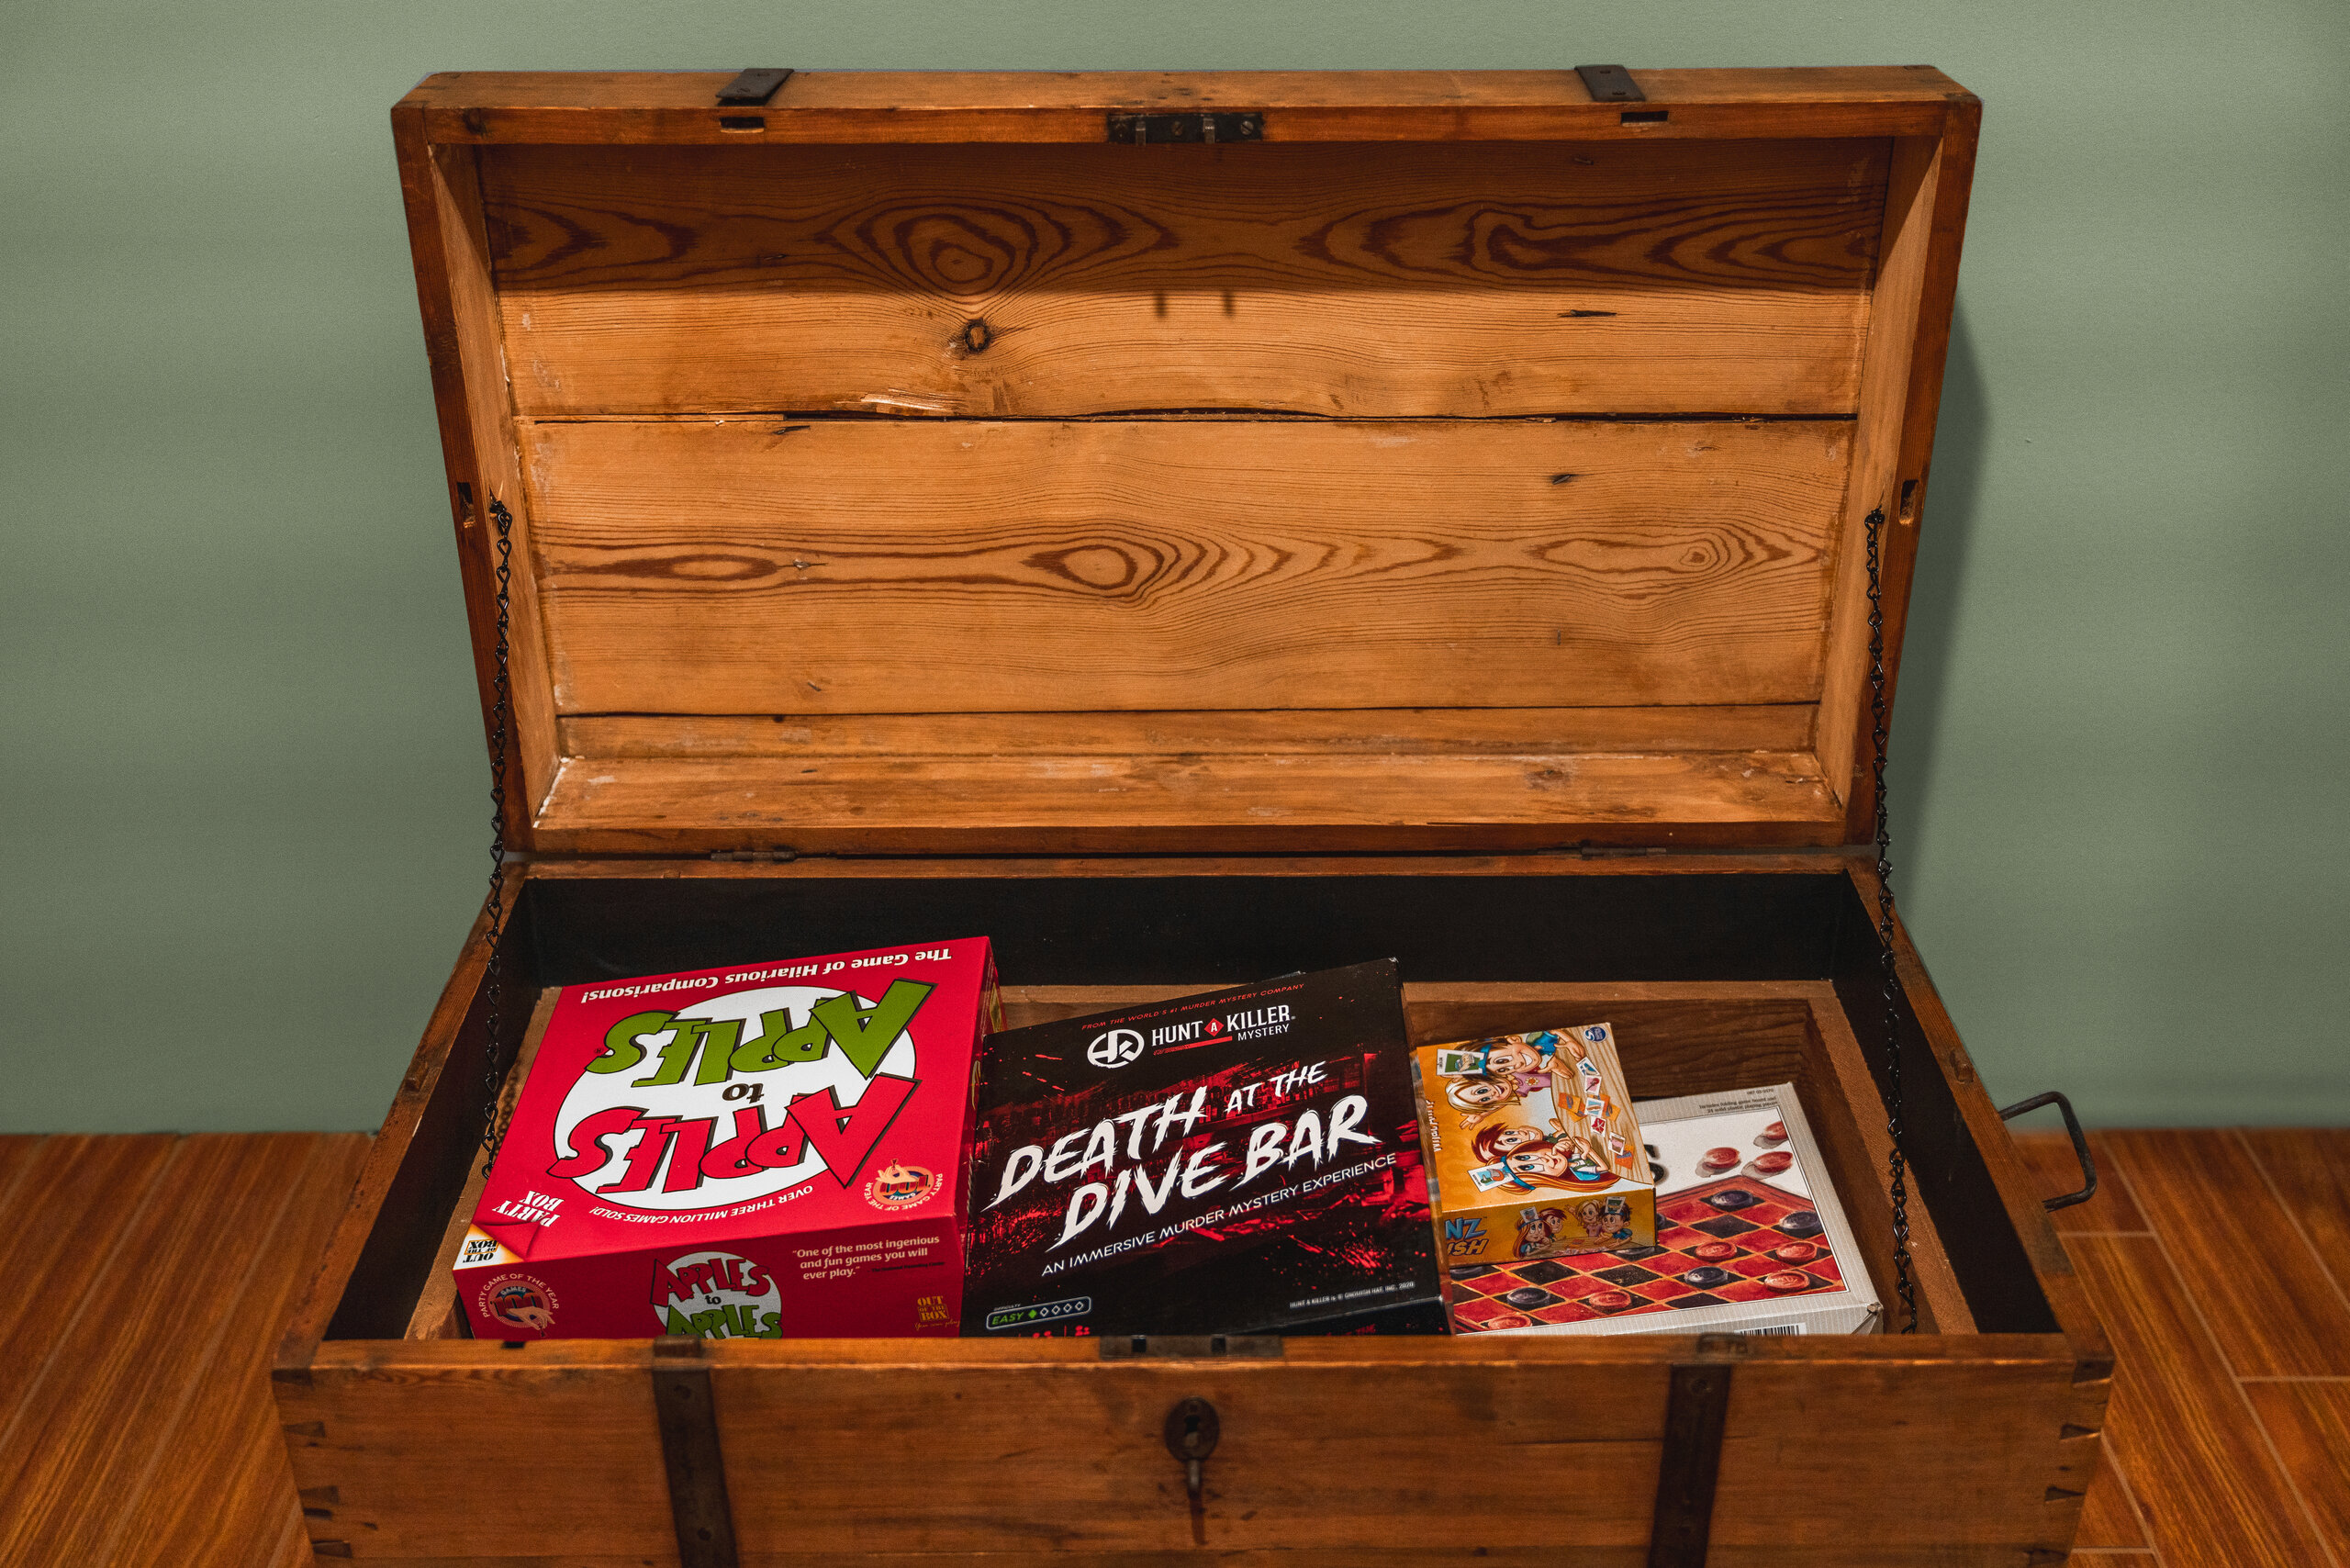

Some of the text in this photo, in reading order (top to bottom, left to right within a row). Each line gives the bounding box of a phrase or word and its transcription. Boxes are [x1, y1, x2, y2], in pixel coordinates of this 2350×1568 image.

[580, 948, 952, 1003] The Game of Hilarious Comparisons!
[1081, 1022, 1106, 1031] FROM
[1128, 1010, 1168, 1022] WORLD'S
[1181, 1000, 1215, 1012] MURDER
[1218, 992, 1258, 1005] MYSTERY
[1260, 983, 1304, 996] COMPANY
[584, 977, 938, 1088] APPLES
[1151, 1004, 1291, 1046] HUNT A KILLER
[1237, 1024, 1290, 1041] MYSTERY
[722, 1083, 765, 1103] to
[545, 1072, 922, 1193] APPLES
[981, 1061, 1328, 1212] DEATH AT THE
[1045, 1094, 1382, 1253] DIVE BAR
[864, 1182, 873, 1200] YEAR
[930, 1173, 943, 1197] PARTY
[519, 1191, 565, 1212] BOX
[588, 1185, 813, 1224] OVER THREE MILLION GAMES SOLD!
[868, 1199, 884, 1210] THE
[901, 1196, 931, 1210] GAME
[491, 1200, 561, 1227] PARTY
[1041, 1152, 1397, 1277] AN IMMERSIVE MURDER MYSTERY EXPERIENCE
[822, 1245, 834, 1257] of
[835, 1244, 854, 1254] the
[856, 1239, 884, 1251] most
[886, 1235, 940, 1249] ingenious
[800, 1248, 928, 1269] and fun games you will
[483, 1274, 509, 1291] GAME
[527, 1275, 546, 1288] THE
[650, 1258, 771, 1307] APPLES
[802, 1271, 826, 1280] ever
[478, 1291, 491, 1317] PARTY
[545, 1287, 559, 1309] YEAR
[705, 1294, 722, 1305] to
[918, 1295, 944, 1306] OUT
[666, 1305, 784, 1339] APPLES
[921, 1311, 947, 1321] BOX
[991, 1312, 1024, 1325] EASY
